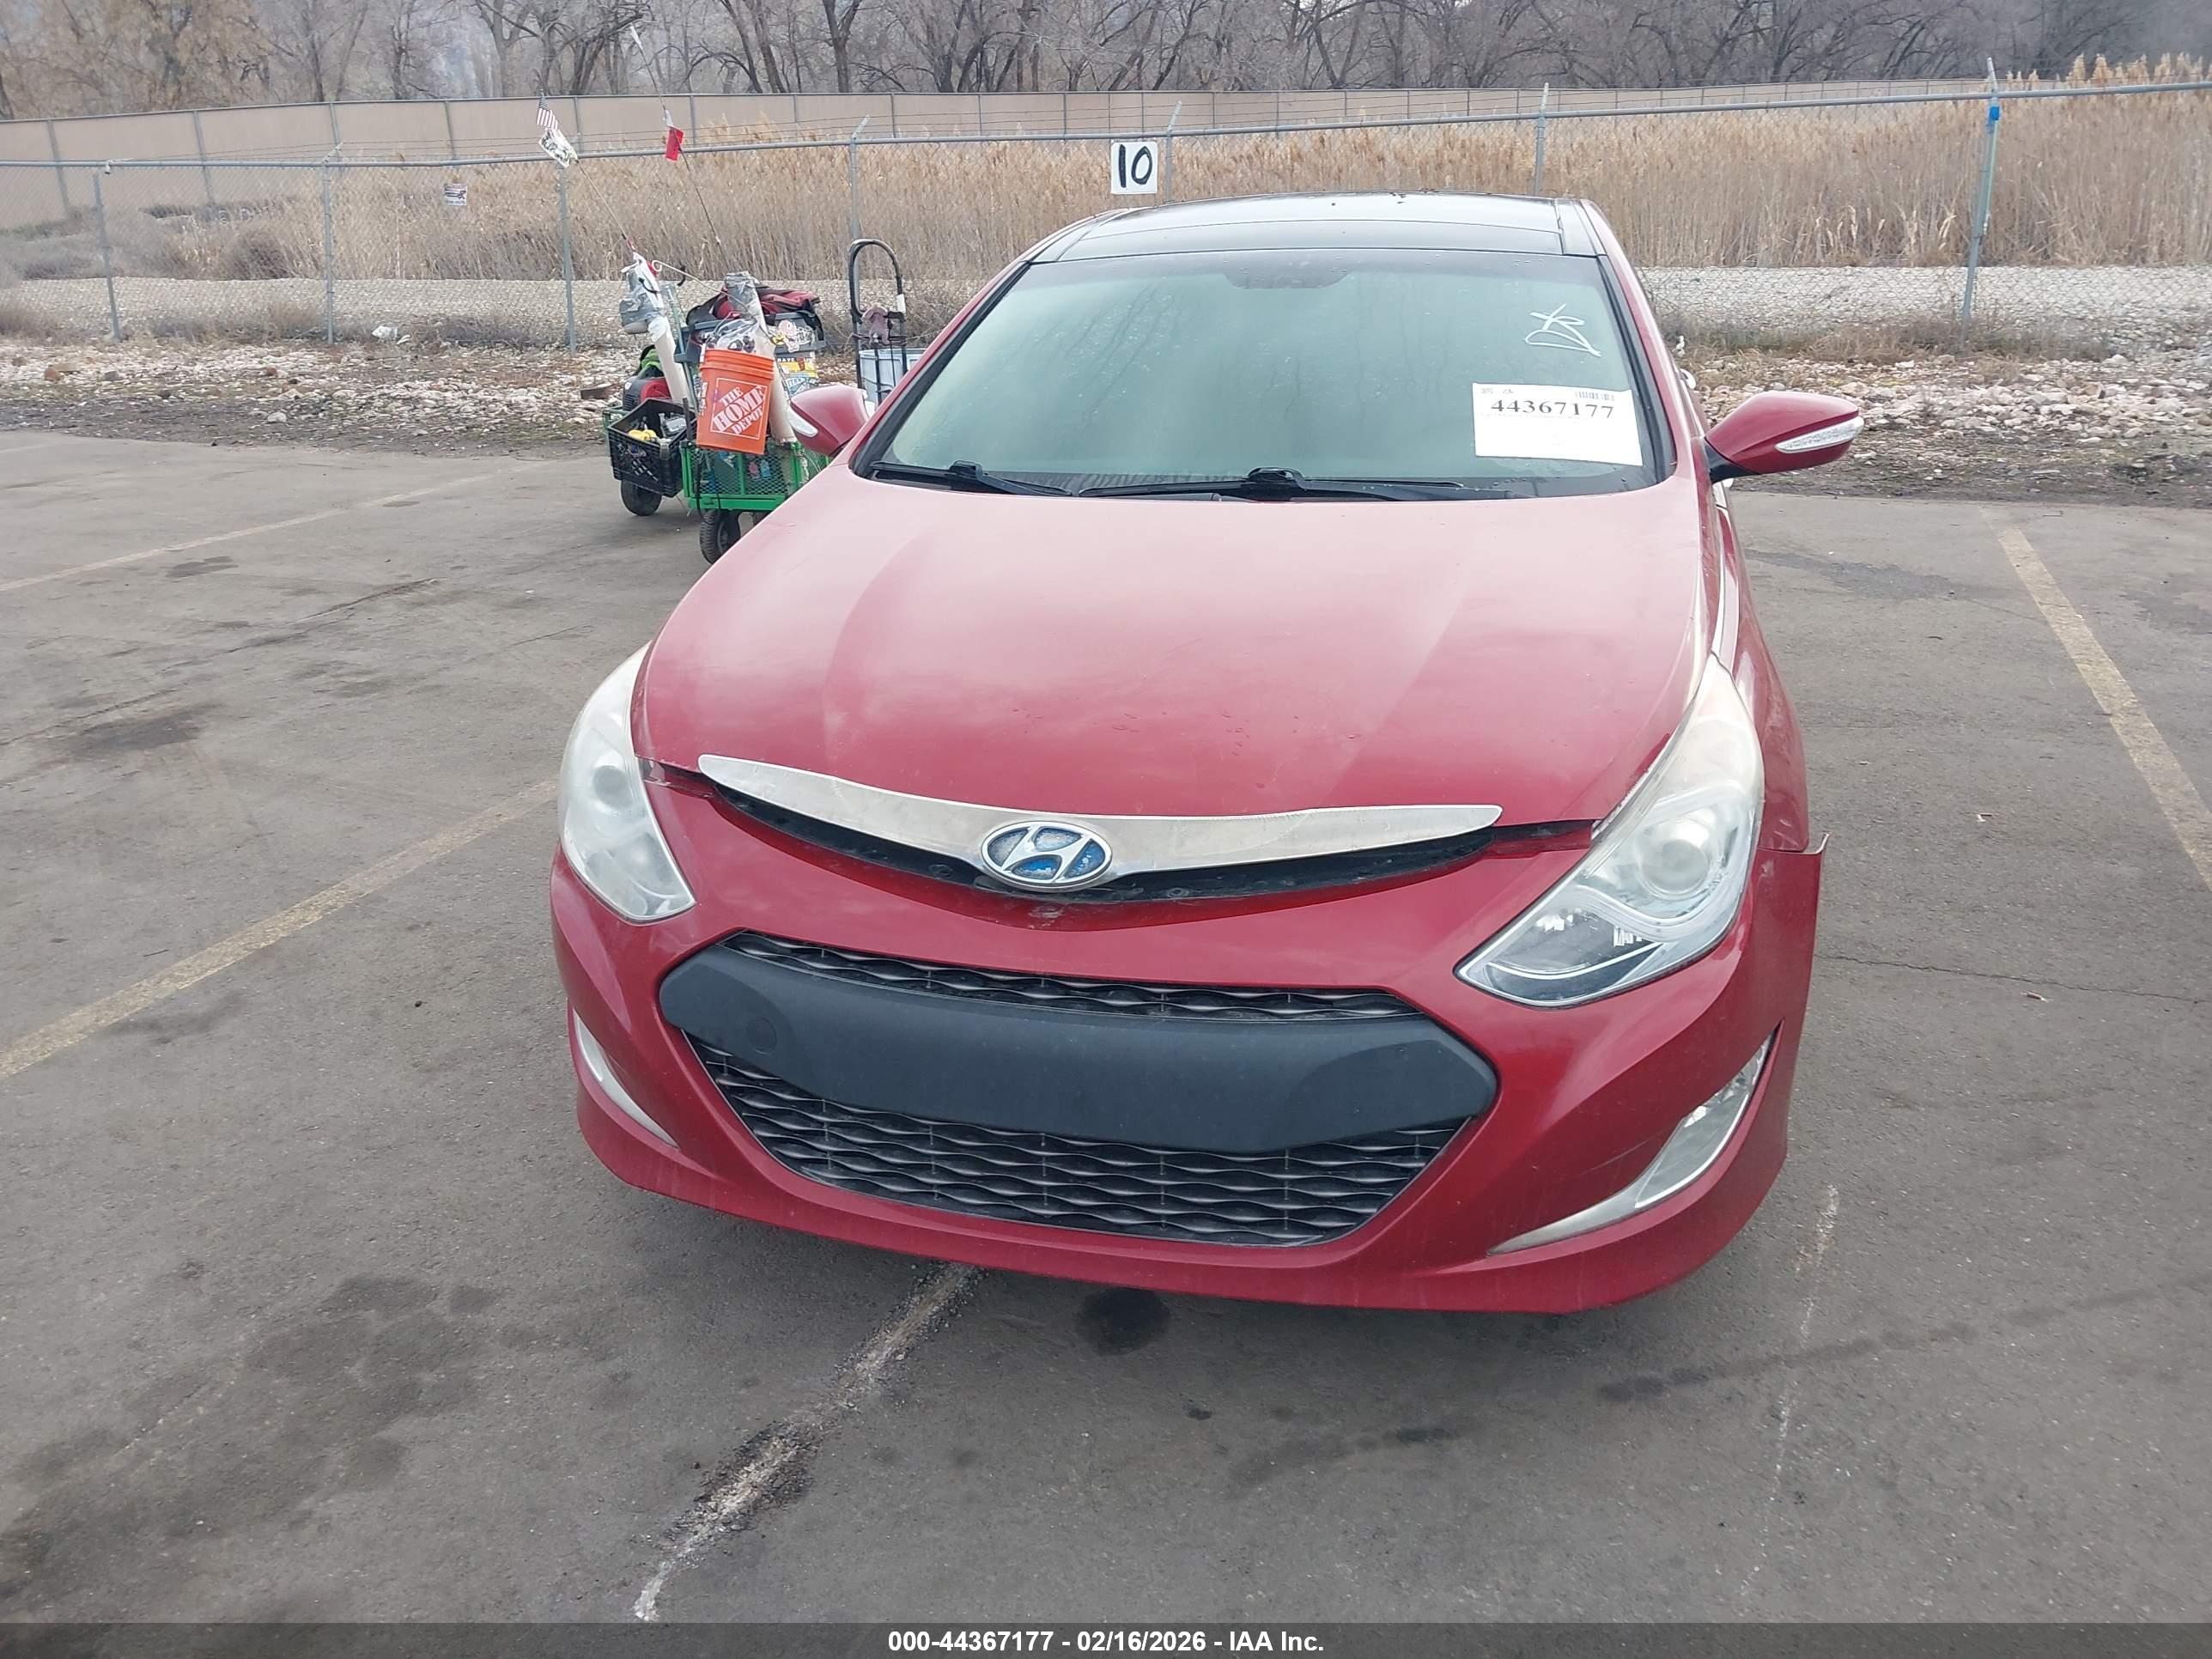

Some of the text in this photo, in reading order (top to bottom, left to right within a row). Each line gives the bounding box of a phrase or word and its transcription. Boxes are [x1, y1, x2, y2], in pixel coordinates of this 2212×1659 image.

[1119, 144, 1152, 188] 10
[713, 385, 764, 432] HOME
[720, 387, 744, 405] THE
[1491, 399, 1614, 418] 44367177
[731, 405, 763, 434] DEPOT
